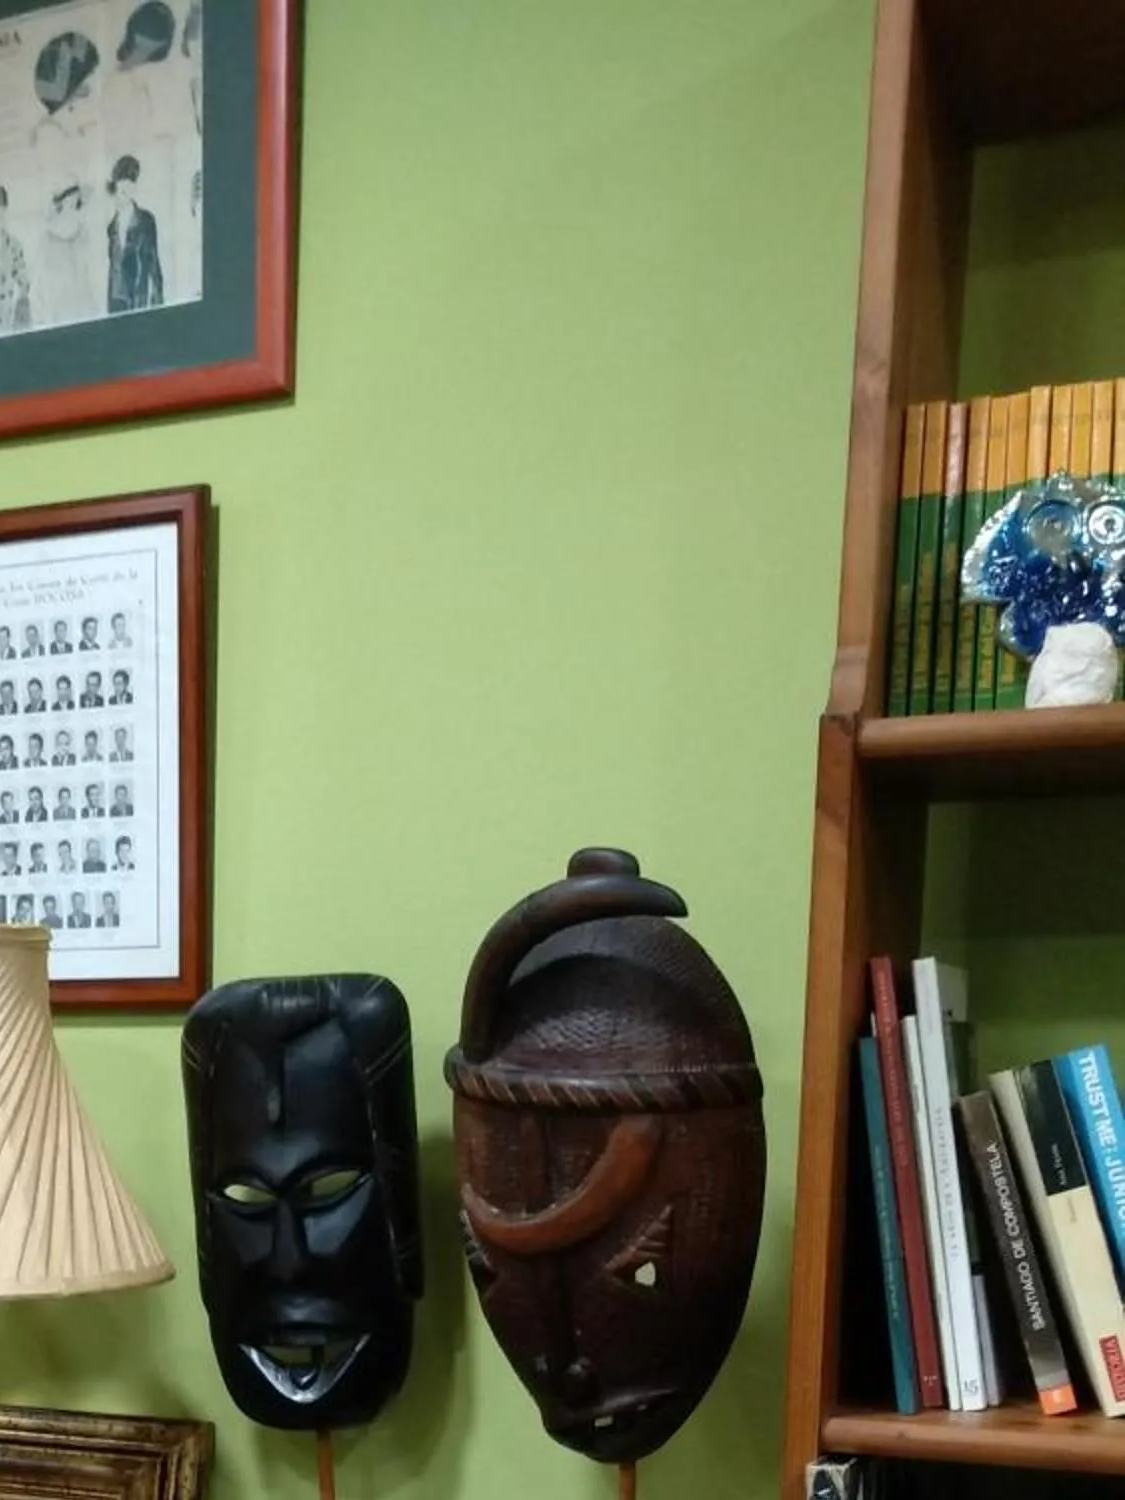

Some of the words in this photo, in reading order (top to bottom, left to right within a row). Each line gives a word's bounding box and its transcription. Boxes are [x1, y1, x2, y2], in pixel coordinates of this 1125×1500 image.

[1079, 1051, 1109, 1117] TRUST
[986, 1140, 1021, 1237] COMPOSTELA
[1011, 1237, 1027, 1260] DE
[1016, 1260, 1046, 1332] SANTIAGO
